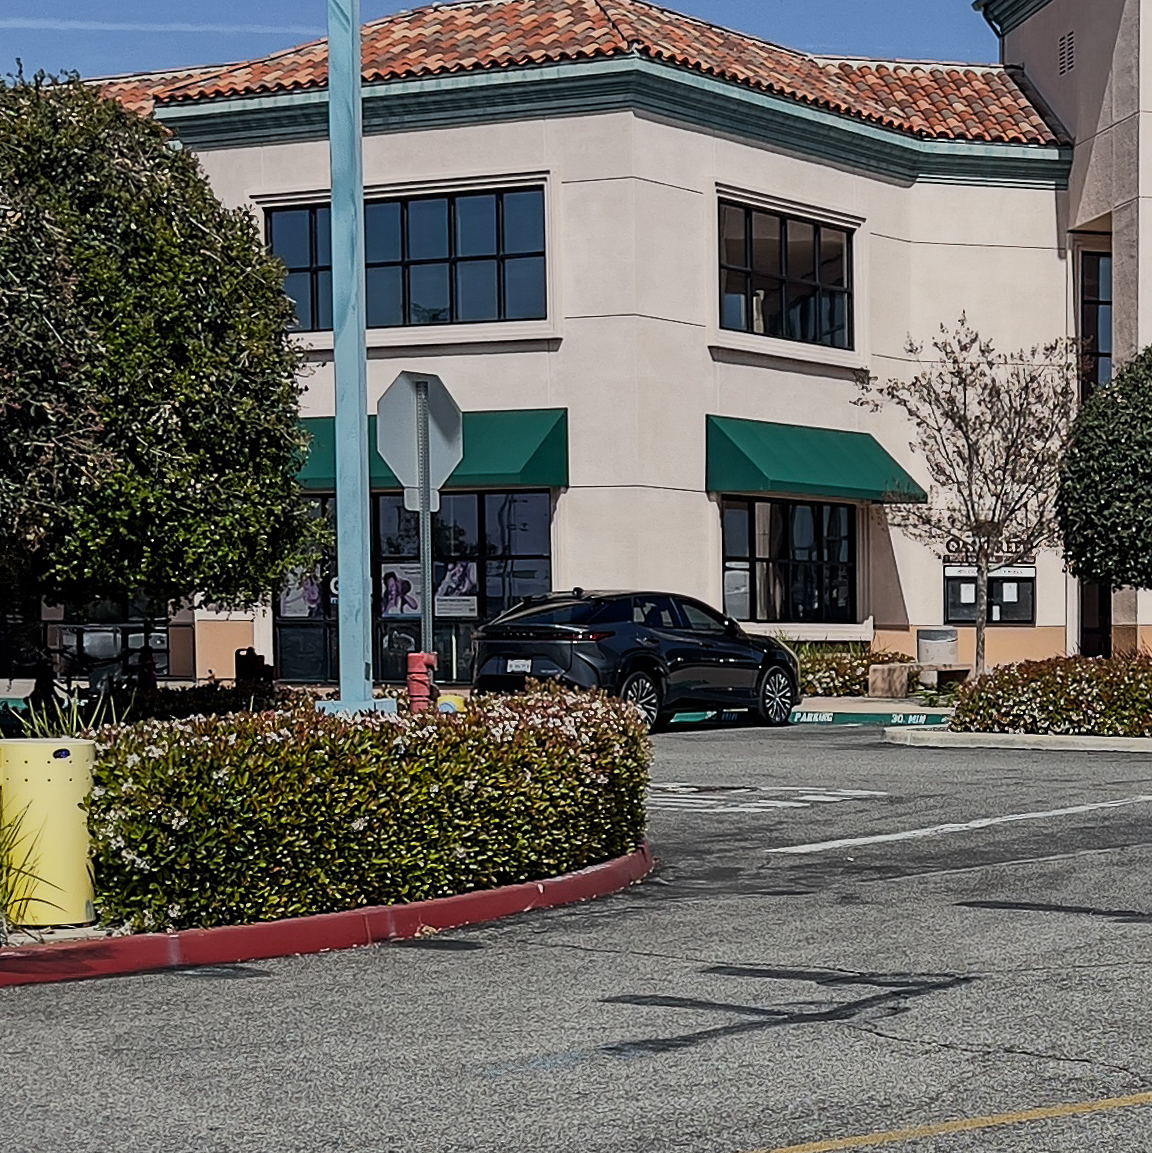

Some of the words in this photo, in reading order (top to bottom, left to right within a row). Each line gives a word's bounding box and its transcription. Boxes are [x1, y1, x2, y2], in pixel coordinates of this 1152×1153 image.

[794, 712, 833, 722] PARKING
[891, 713, 904, 723] 30
[908, 714, 926, 724] MIN
